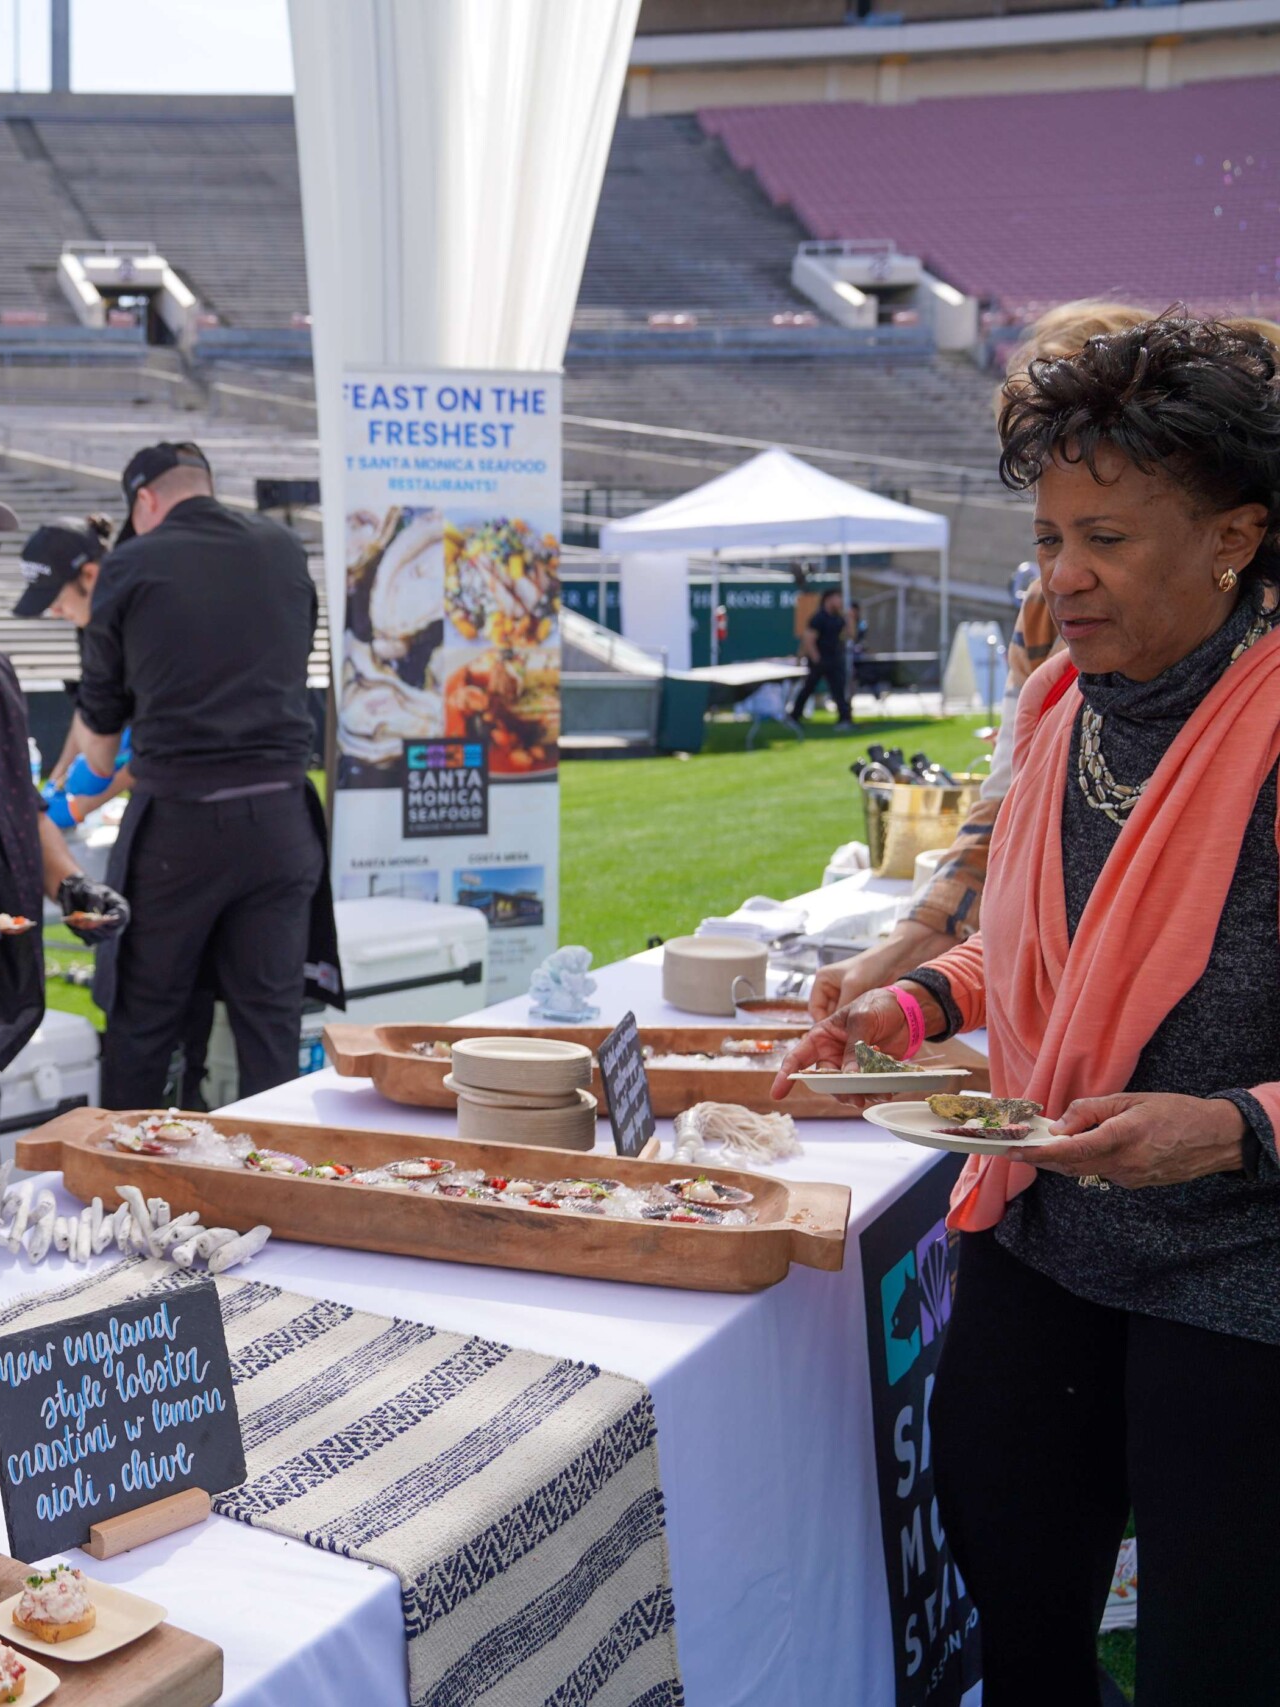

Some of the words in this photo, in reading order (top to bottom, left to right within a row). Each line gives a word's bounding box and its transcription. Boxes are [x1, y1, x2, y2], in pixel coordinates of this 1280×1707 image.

[344, 384, 427, 411] EAST
[436, 387, 482, 412] ON
[491, 388, 546, 415] THE
[368, 420, 515, 448] FRESHEST
[358, 456, 411, 470] SANTA
[414, 458, 474, 472] MONICA
[478, 459, 547, 474] SEAFOOD
[408, 769, 482, 791] SANTA
[408, 788, 482, 807] MONICA
[408, 805, 483, 823] SEAFOOD
[64, 1302, 181, 1378] england
[41, 1375, 107, 1432] style
[116, 1344, 210, 1402] lobster
[152, 1387, 225, 1433] lemon
[122, 1442, 194, 1492] chive
